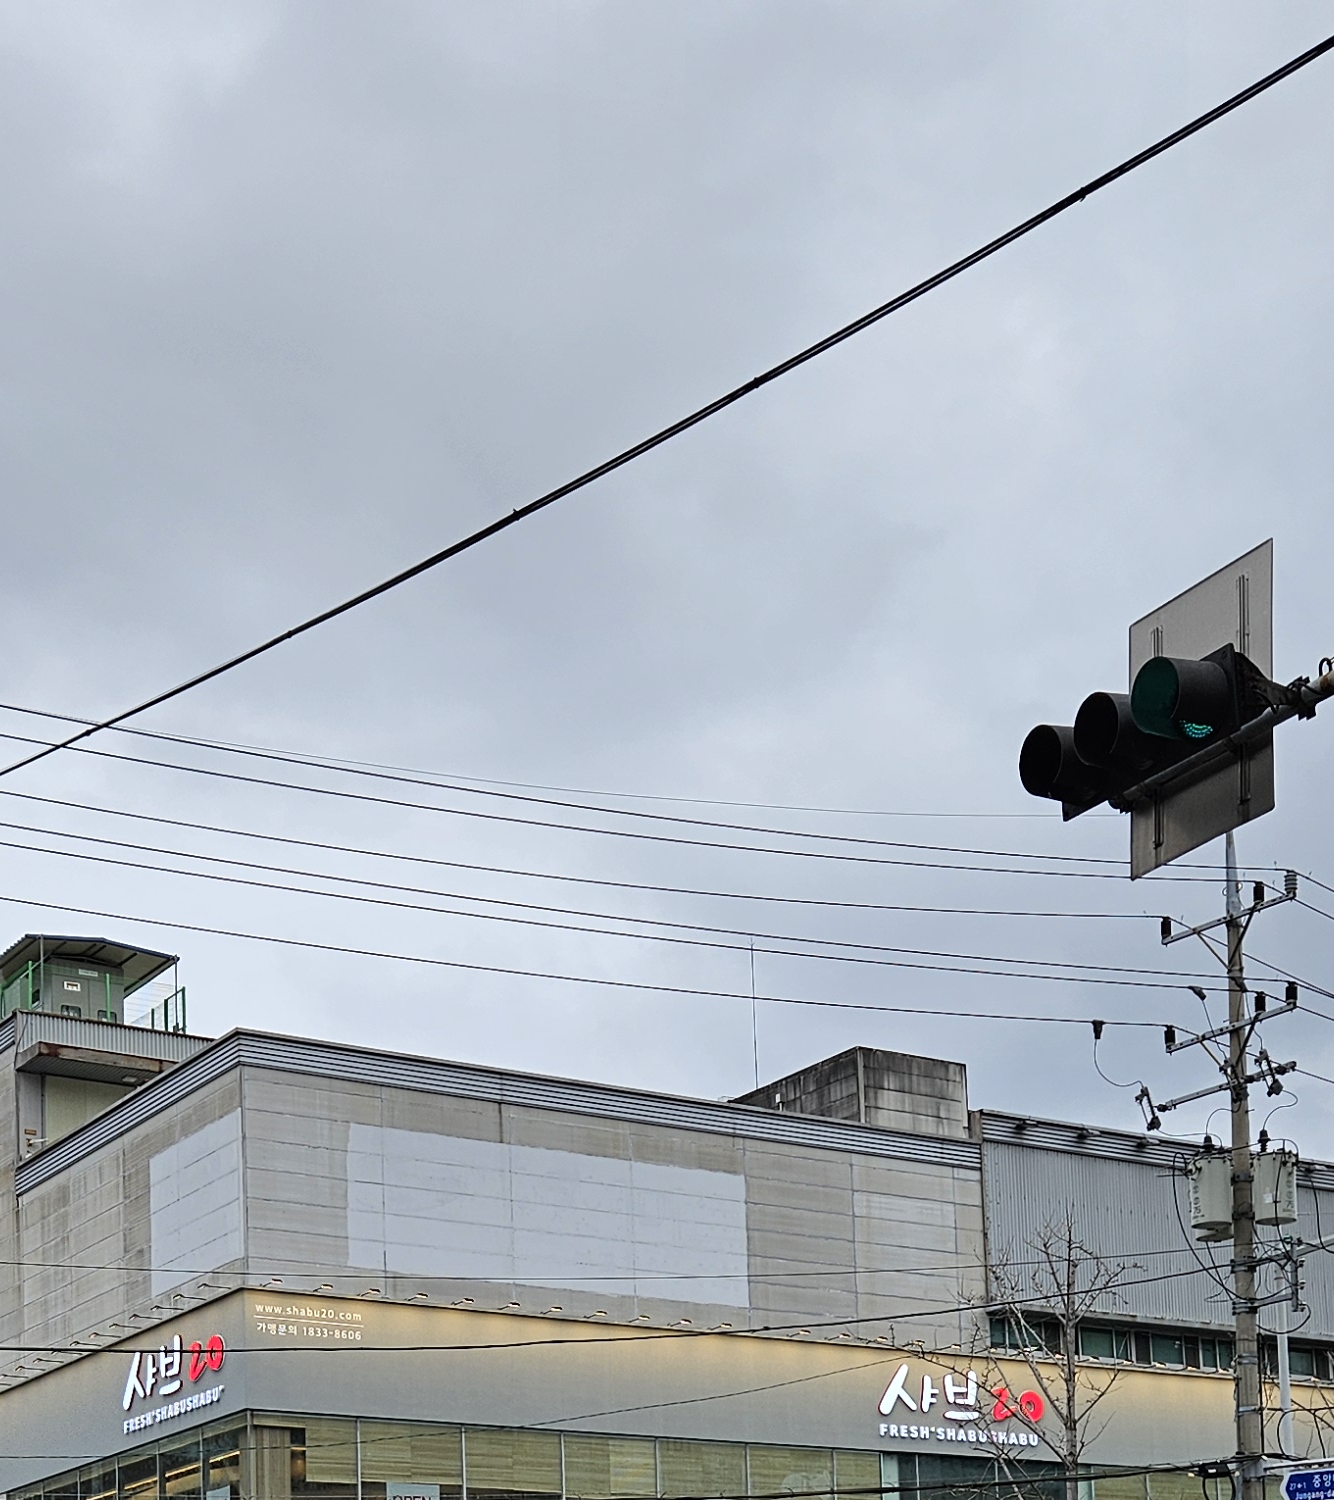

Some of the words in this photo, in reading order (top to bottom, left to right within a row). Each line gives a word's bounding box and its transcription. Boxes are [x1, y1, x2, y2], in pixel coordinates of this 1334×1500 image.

[255, 1304, 362, 1322] www.shabu20.com
[256, 1322, 298, 1336] 가맹문의
[302, 1326, 362, 1341] 1833-8606
